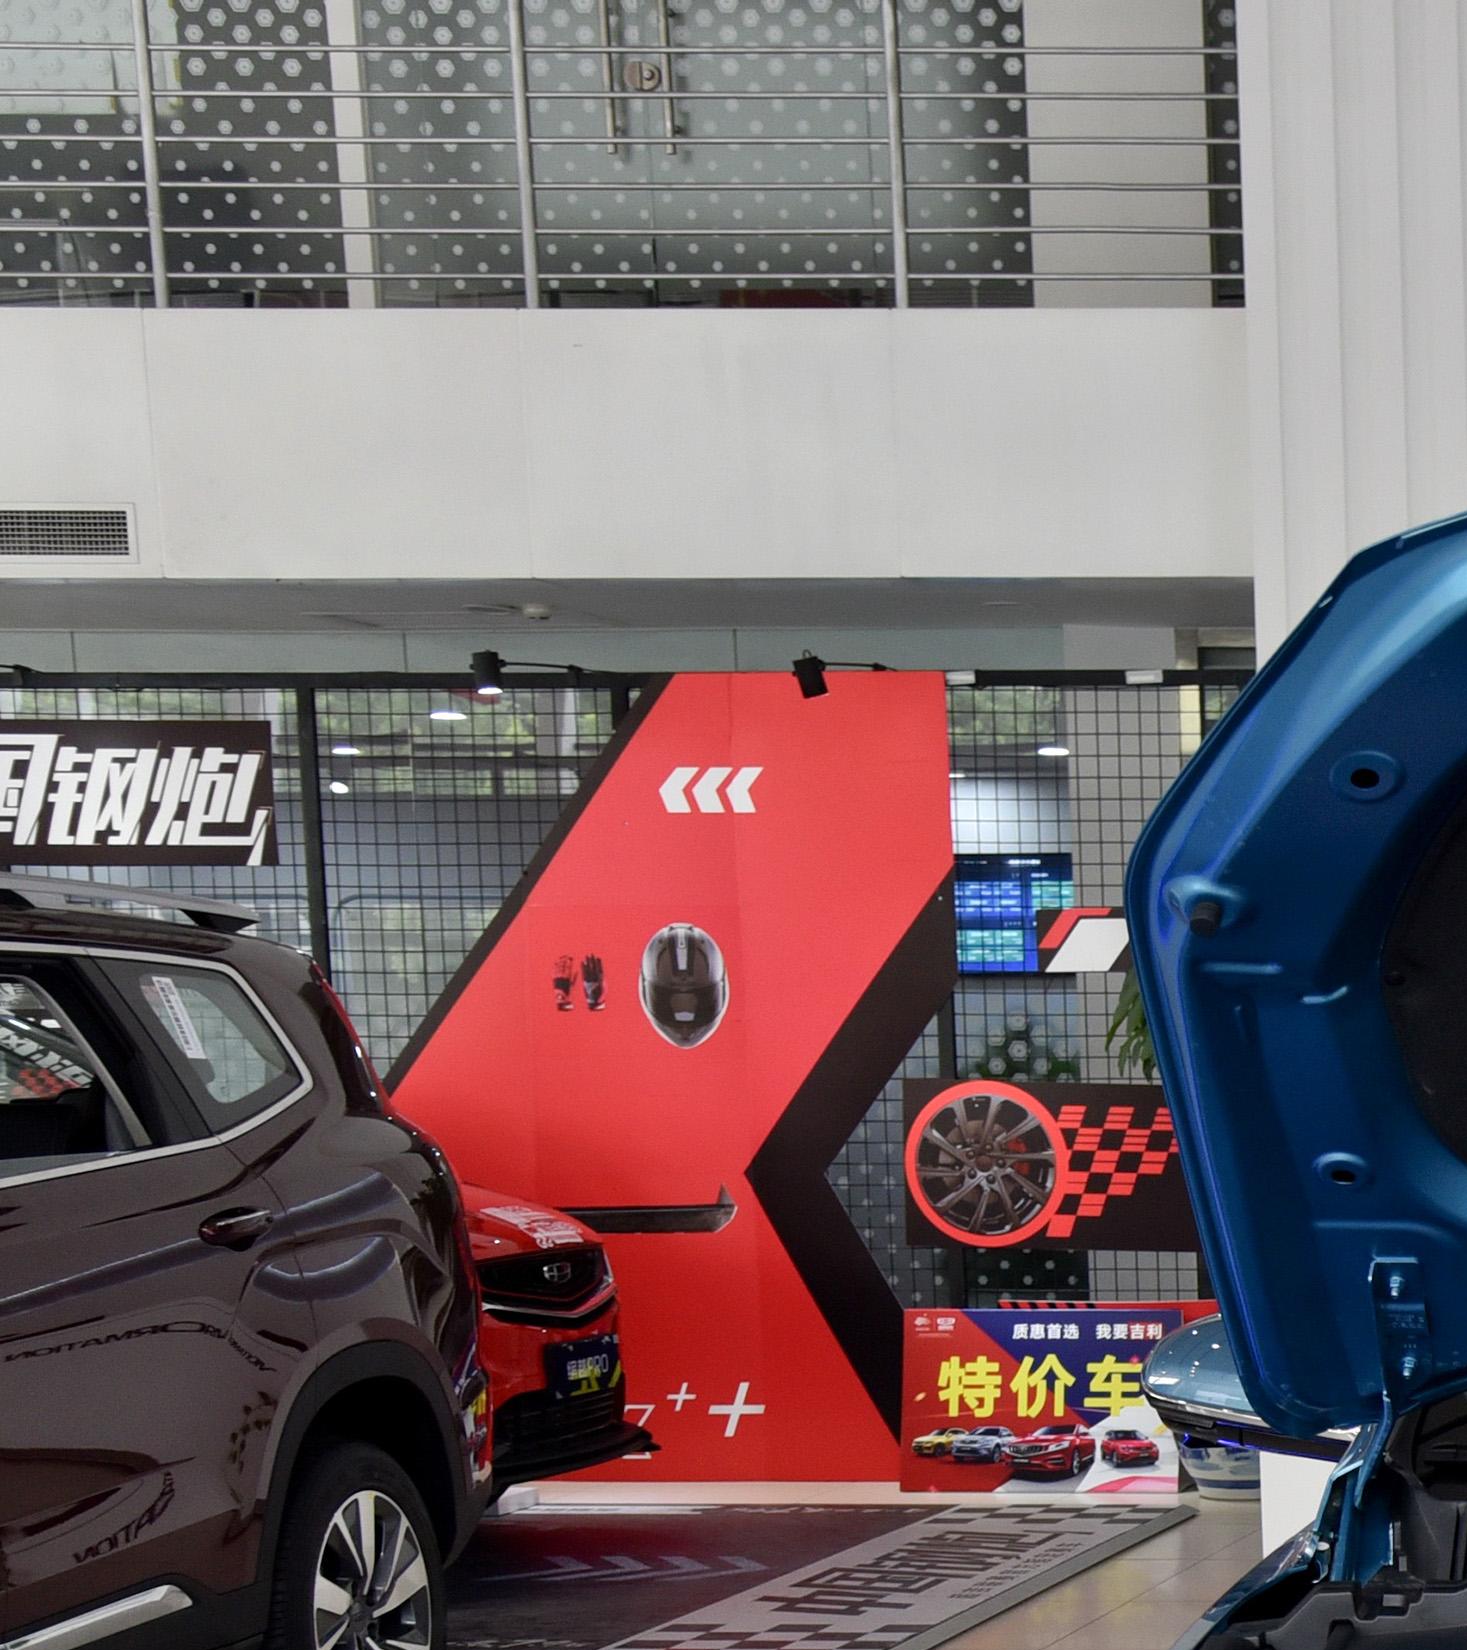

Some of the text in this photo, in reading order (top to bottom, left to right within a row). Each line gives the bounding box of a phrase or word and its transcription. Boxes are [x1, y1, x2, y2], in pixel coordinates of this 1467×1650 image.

[1012, 1323, 1164, 1341] 质惠首选 我要吉利
[937, 1353, 1146, 1419] 特价车
